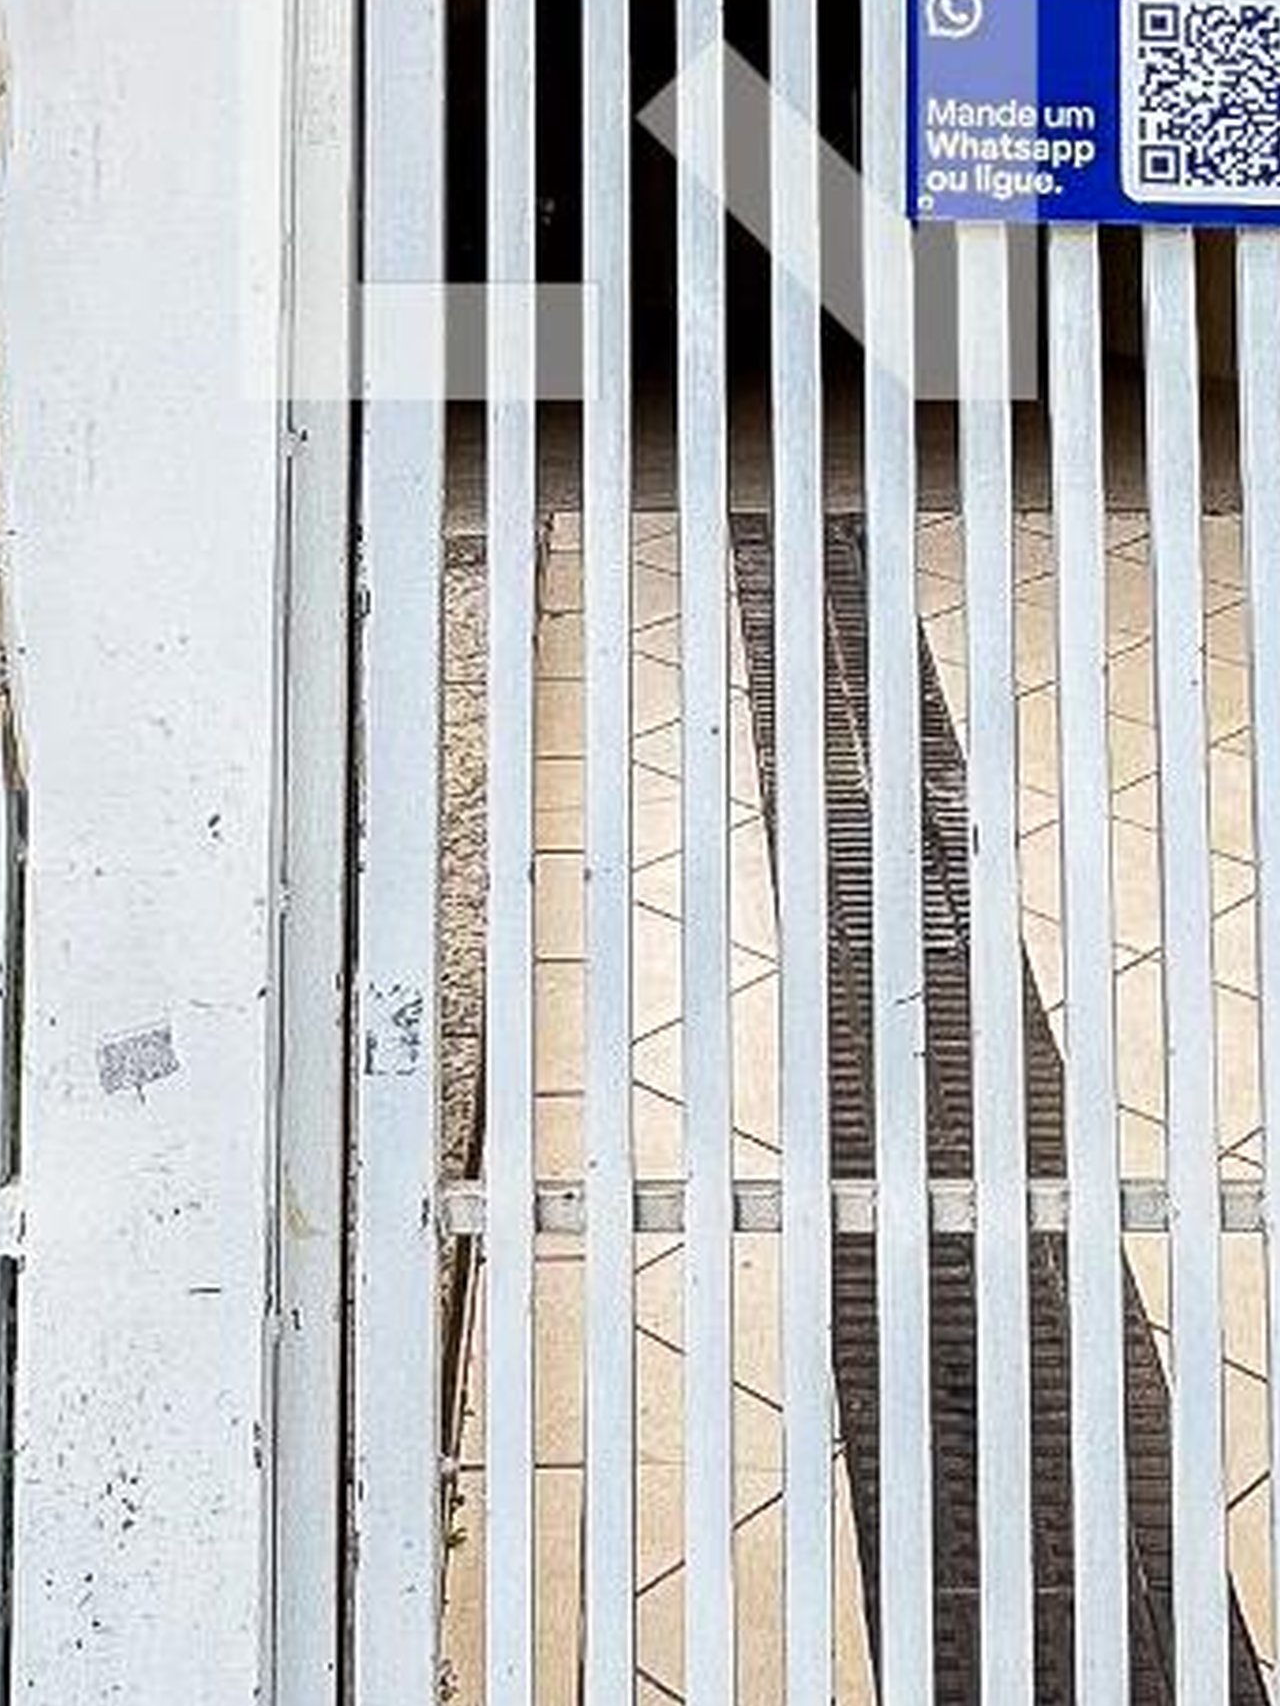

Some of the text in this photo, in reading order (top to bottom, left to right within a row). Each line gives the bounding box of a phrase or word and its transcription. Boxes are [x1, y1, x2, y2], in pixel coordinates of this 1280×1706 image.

[927, 99, 1095, 129] Mande um
[926, 129, 1096, 168] Whatsapp
[926, 163, 1064, 201] ou ligue.
